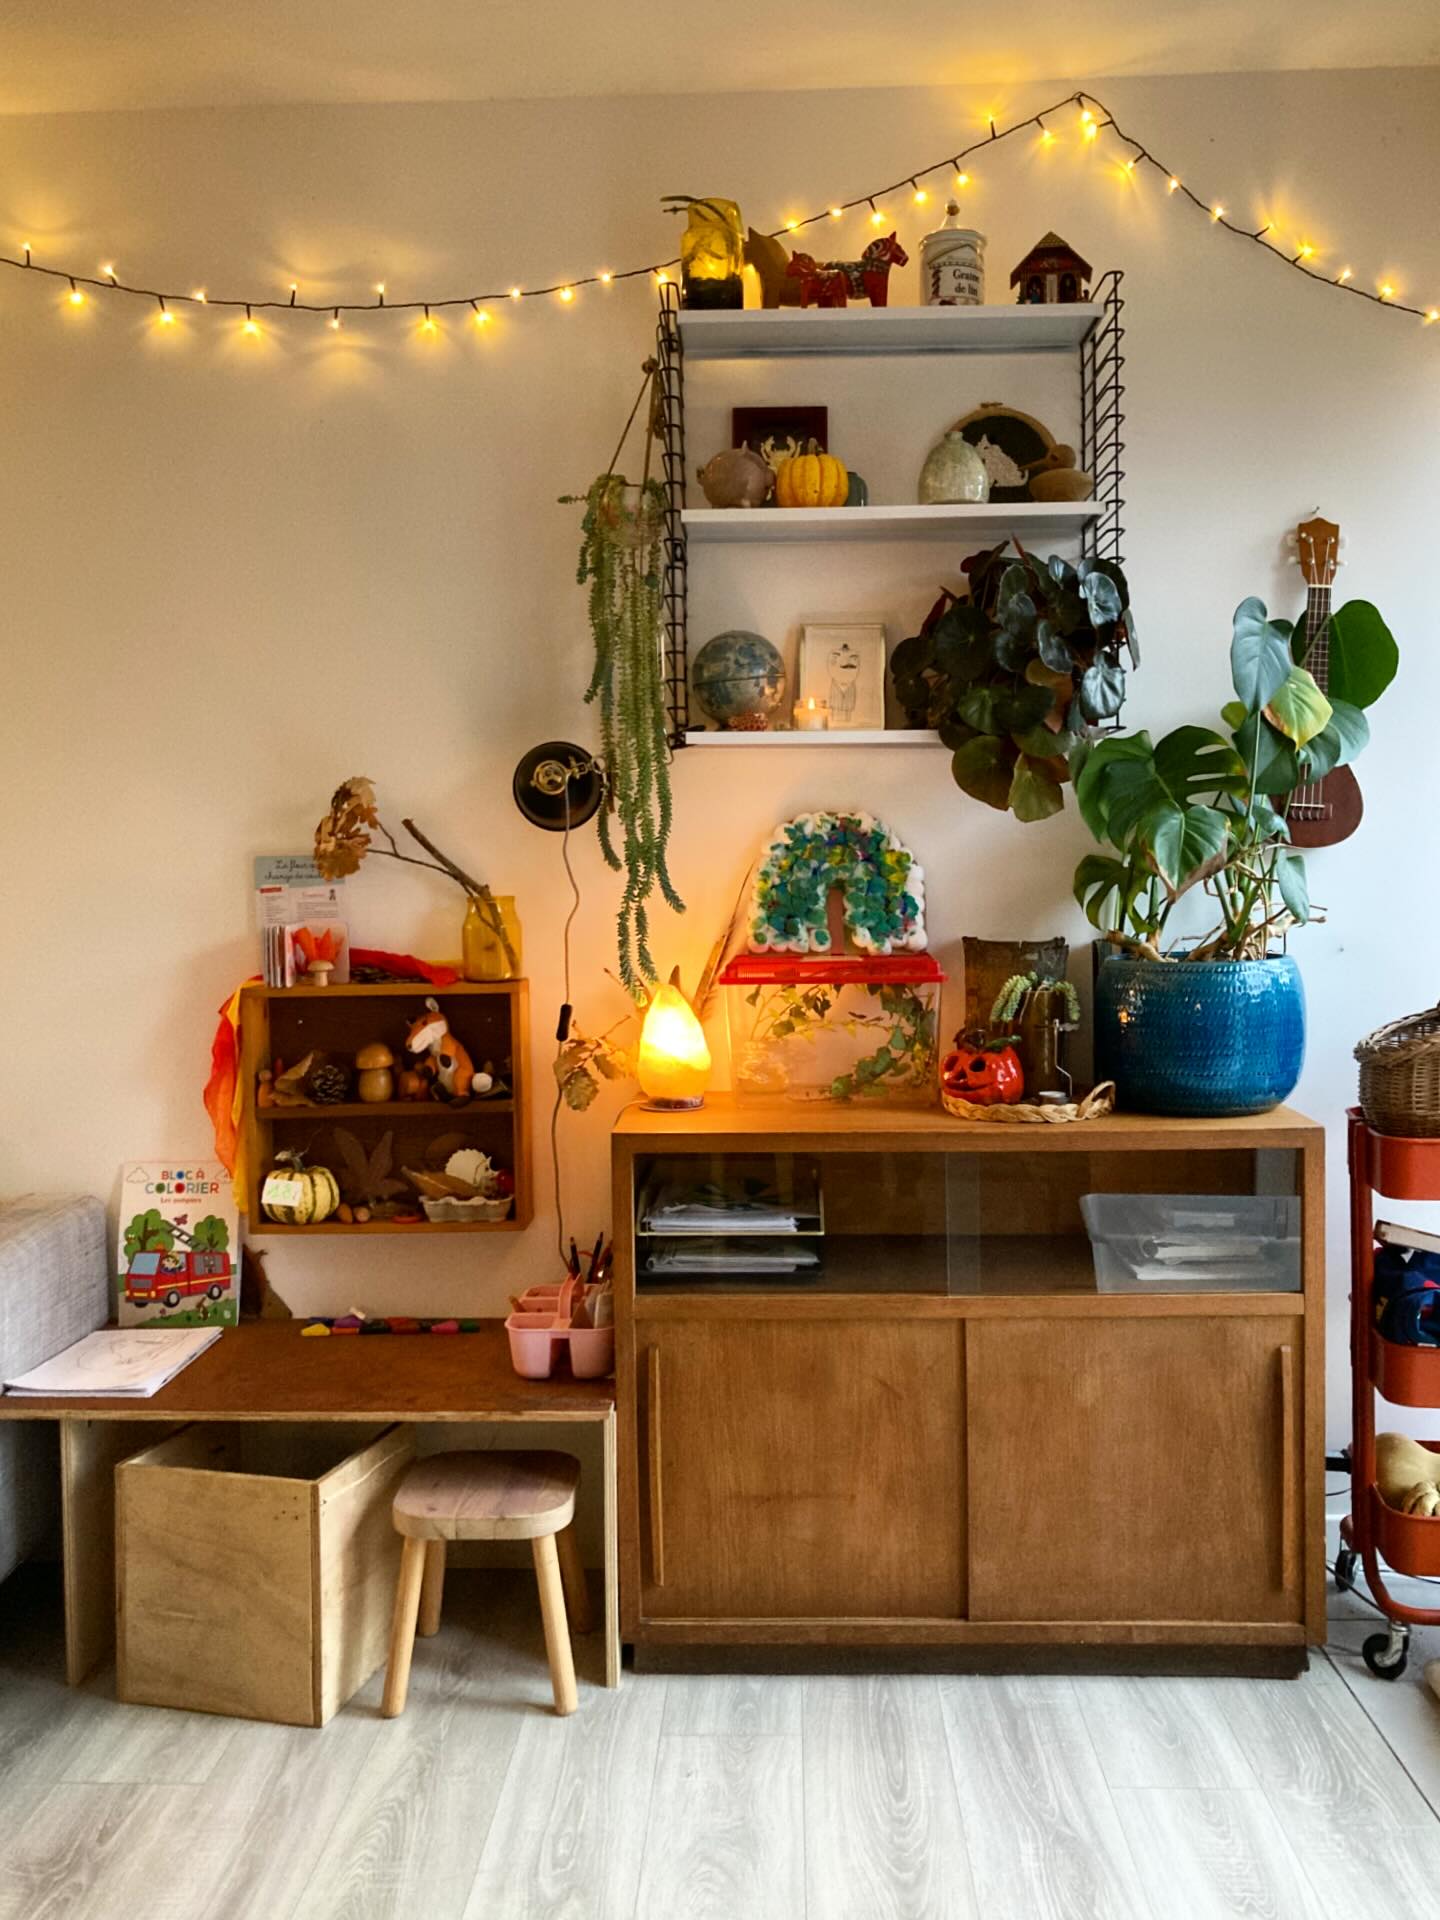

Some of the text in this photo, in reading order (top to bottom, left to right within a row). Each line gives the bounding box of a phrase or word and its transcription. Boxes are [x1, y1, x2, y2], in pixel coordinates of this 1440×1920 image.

[954, 282, 966, 293] de
[161, 1170, 192, 1180] BLOC
[145, 1182, 219, 1194] COLORIER
